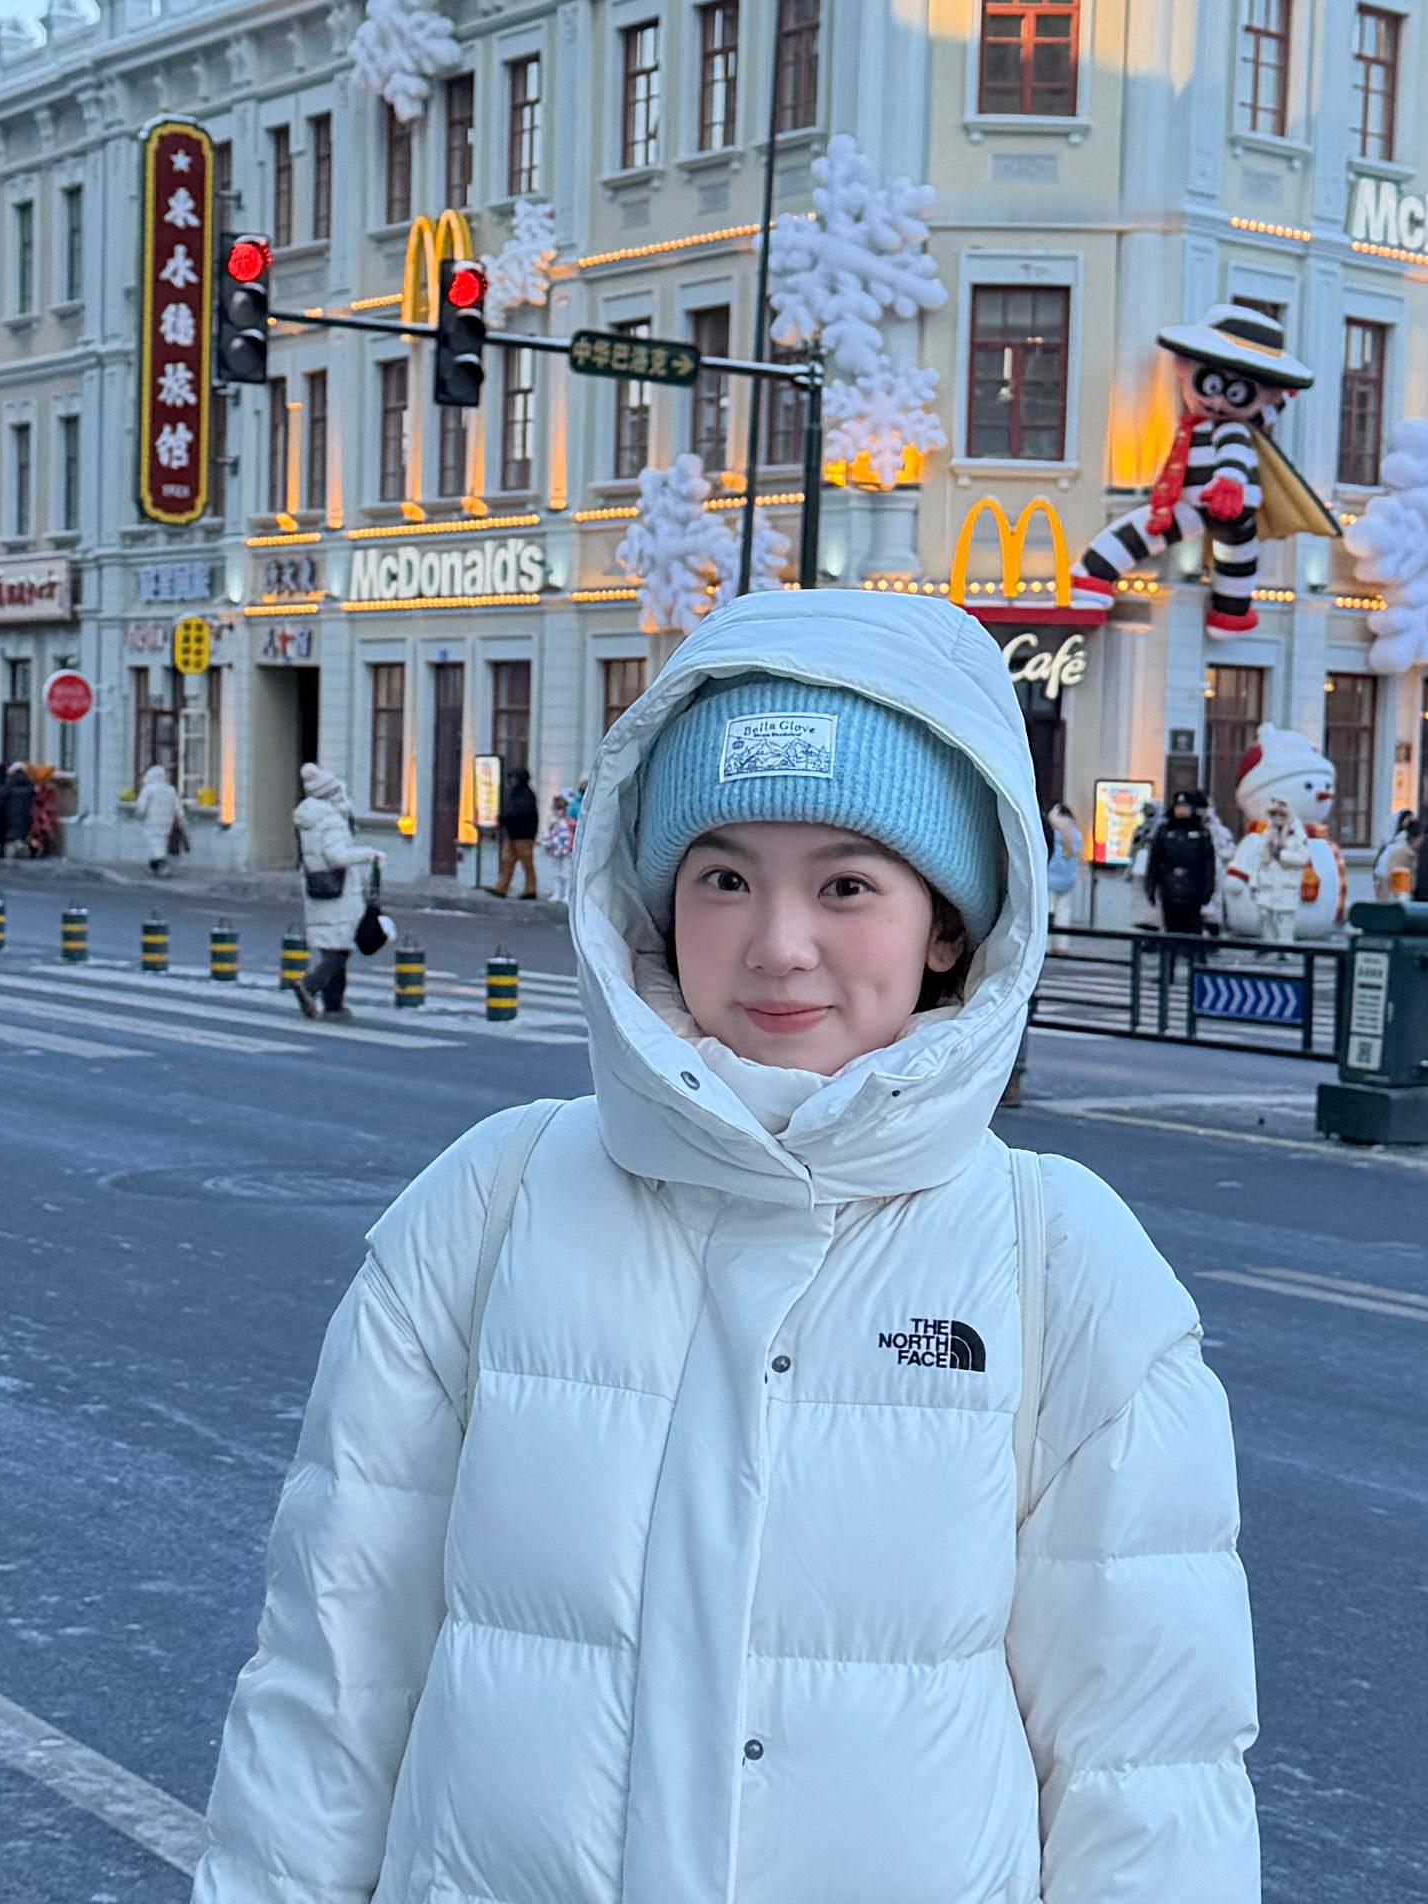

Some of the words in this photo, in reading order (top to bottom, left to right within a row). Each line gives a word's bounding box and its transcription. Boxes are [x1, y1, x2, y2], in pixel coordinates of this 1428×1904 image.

[349, 538, 544, 601] McDonald's
[743, 721, 776, 736] Bella
[778, 720, 816, 734] Glove
[910, 1318, 950, 1336] THE
[878, 1332, 949, 1353] NORTH
[897, 1349, 948, 1368] FACE
